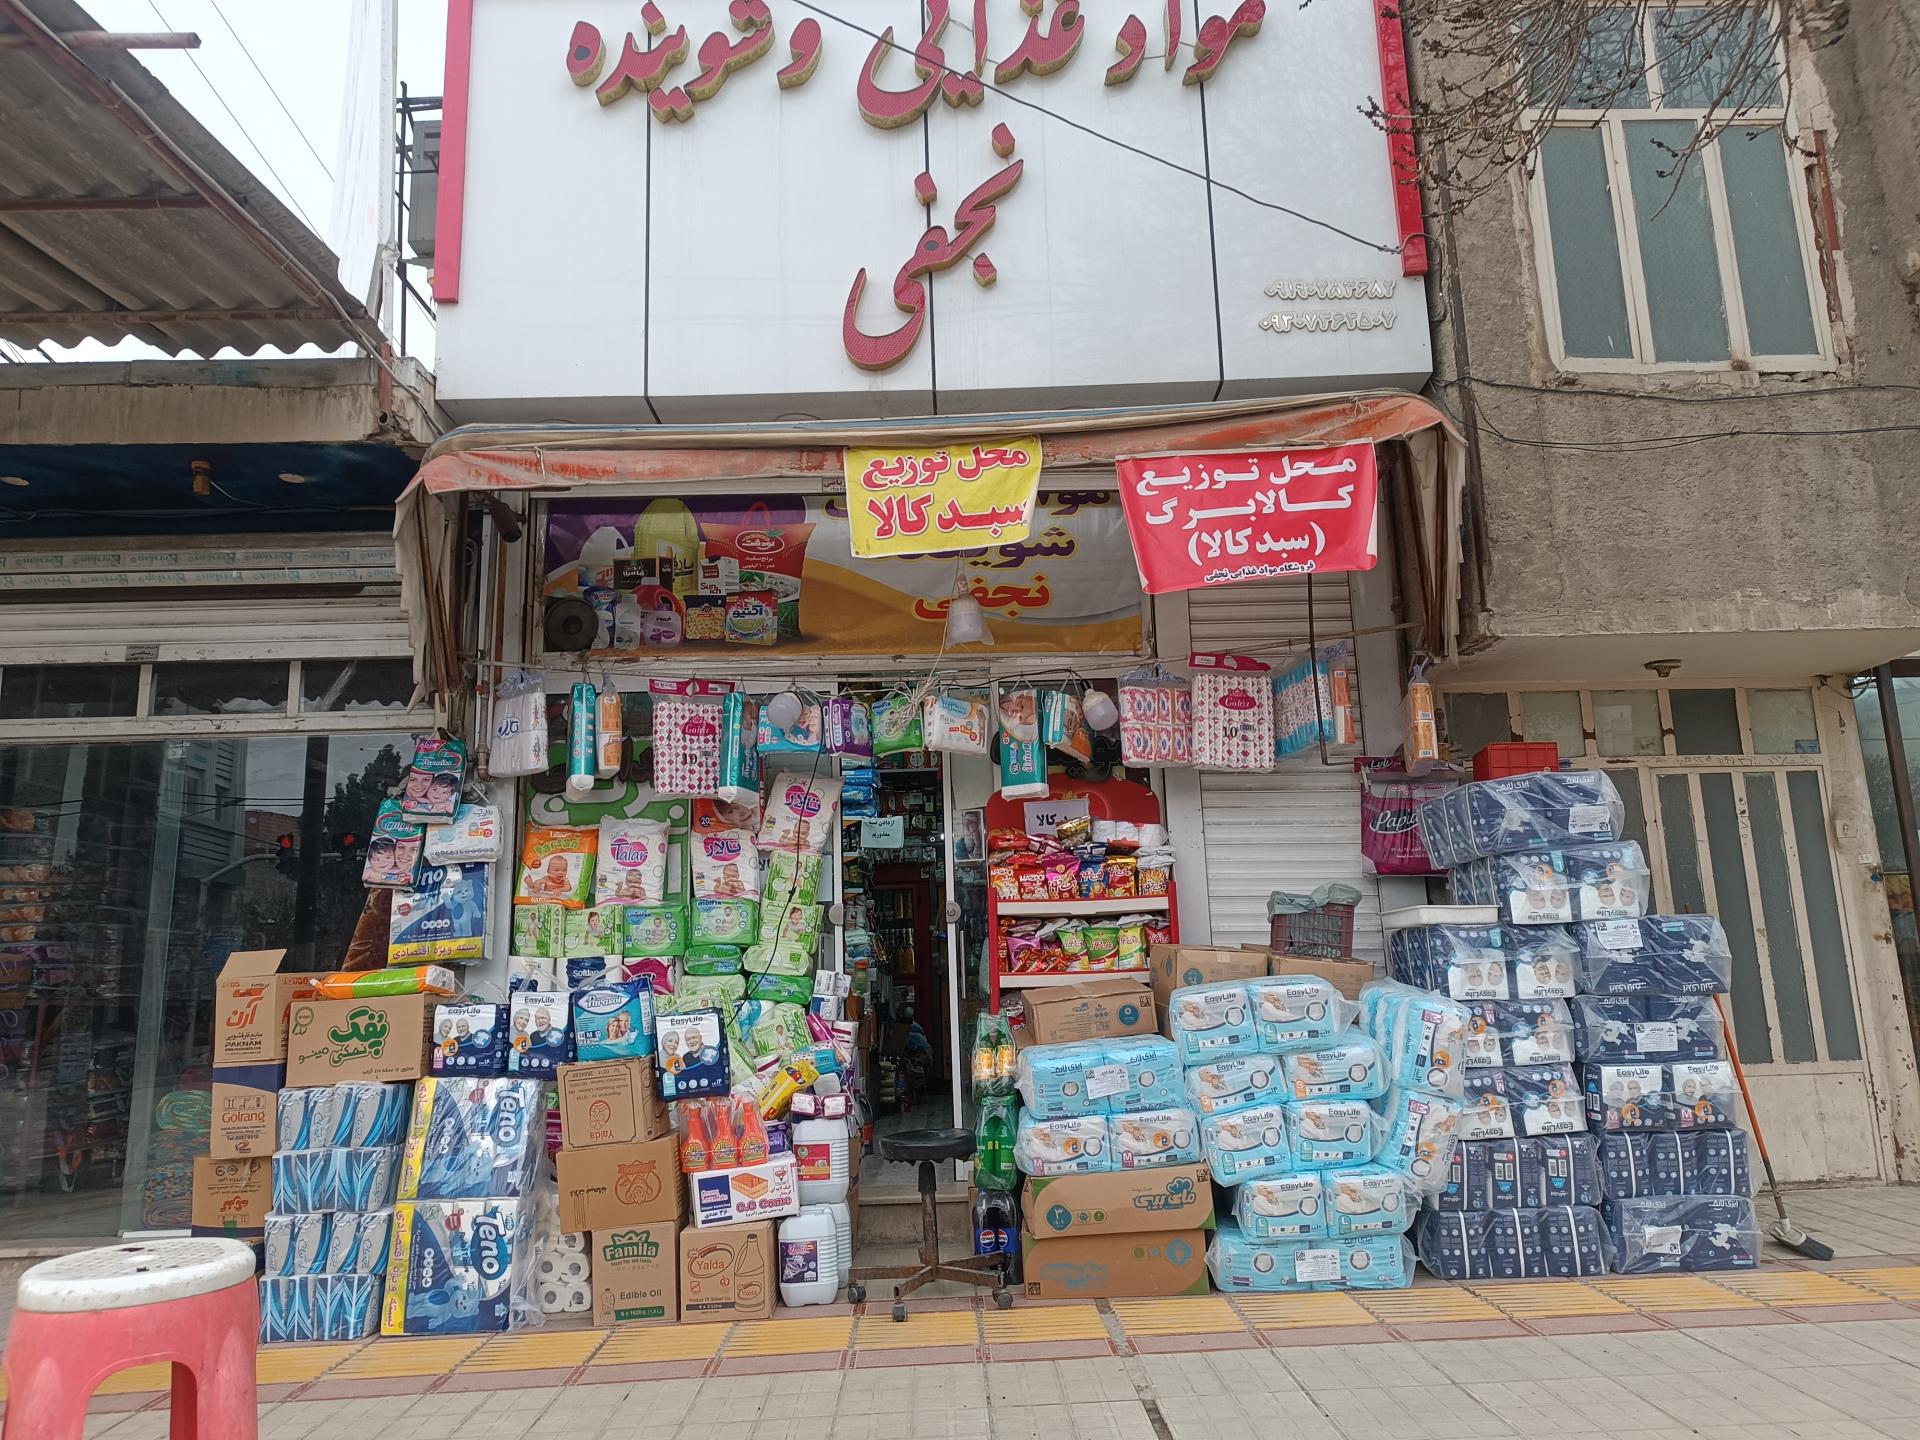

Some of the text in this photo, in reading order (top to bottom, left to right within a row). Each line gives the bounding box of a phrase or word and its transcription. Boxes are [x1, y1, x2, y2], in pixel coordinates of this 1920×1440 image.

[1105, 0, 1267, 86] مواد
[566, 0, 776, 123] شوینده
[857, 0, 1085, 129] غذایی
[842, 122, 1025, 372] نجفی
[862, 445, 1030, 490] محل توزیع
[1135, 455, 1357, 496] محل توزیع
[867, 494, 1028, 539] سبد کالا
[1258, 566, 1278, 576] مواد
[1279, 561, 1315, 573] فروشگاه
[1206, 570, 1229, 582] نجفی
[1223, 726, 1238, 738] 10
[701, 816, 710, 825] 20
[1036, 813, 1057, 827] کالا
[610, 842, 648, 860] Talar
[1204, 991, 1238, 1004] EasyLife
[1286, 987, 1320, 998] EasyLife
[524, 996, 555, 1005] EasyLife
[670, 1015, 704, 1026] EasyLife
[224, 1040, 262, 1048] PAKNAM
[299, 1047, 329, 1064] مینو
[330, 1045, 368, 1067] نمکی
[434, 1050, 443, 1058] M
[1316, 1051, 1347, 1061] EasyLife
[1529, 1054, 1561, 1063] EasyLife
[1216, 1059, 1246, 1071] EasyLife
[1688, 1065, 1719, 1075] EasyLife
[1616, 1068, 1650, 1078] EasyLife
[498, 1087, 525, 1143] Teno
[1242, 1111, 1275, 1123] EasyLife
[1328, 1107, 1361, 1117] EasyLife
[1606, 1111, 1618, 1120] M
[1681, 1109, 1693, 1119] M
[222, 1112, 265, 1125] Golrang
[1139, 1115, 1172, 1124] EasyLife
[1049, 1121, 1082, 1131] EasyLife
[1541, 1122, 1574, 1132] EasyLife
[590, 1129, 615, 1140] Yalda
[1470, 1128, 1504, 1138] EasyLife
[1124, 1152, 1133, 1160] M
[1034, 1158, 1043, 1167] M
[1280, 1181, 1314, 1191] EasyLife
[1362, 1178, 1395, 1188] EasyLife
[1054, 1207, 1064, 1220] ۳
[477, 1211, 506, 1275] Teno
[605, 1242, 658, 1261] Famila
[696, 1260, 725, 1271] Yalda
[620, 1289, 662, 1300] Edible Oil
